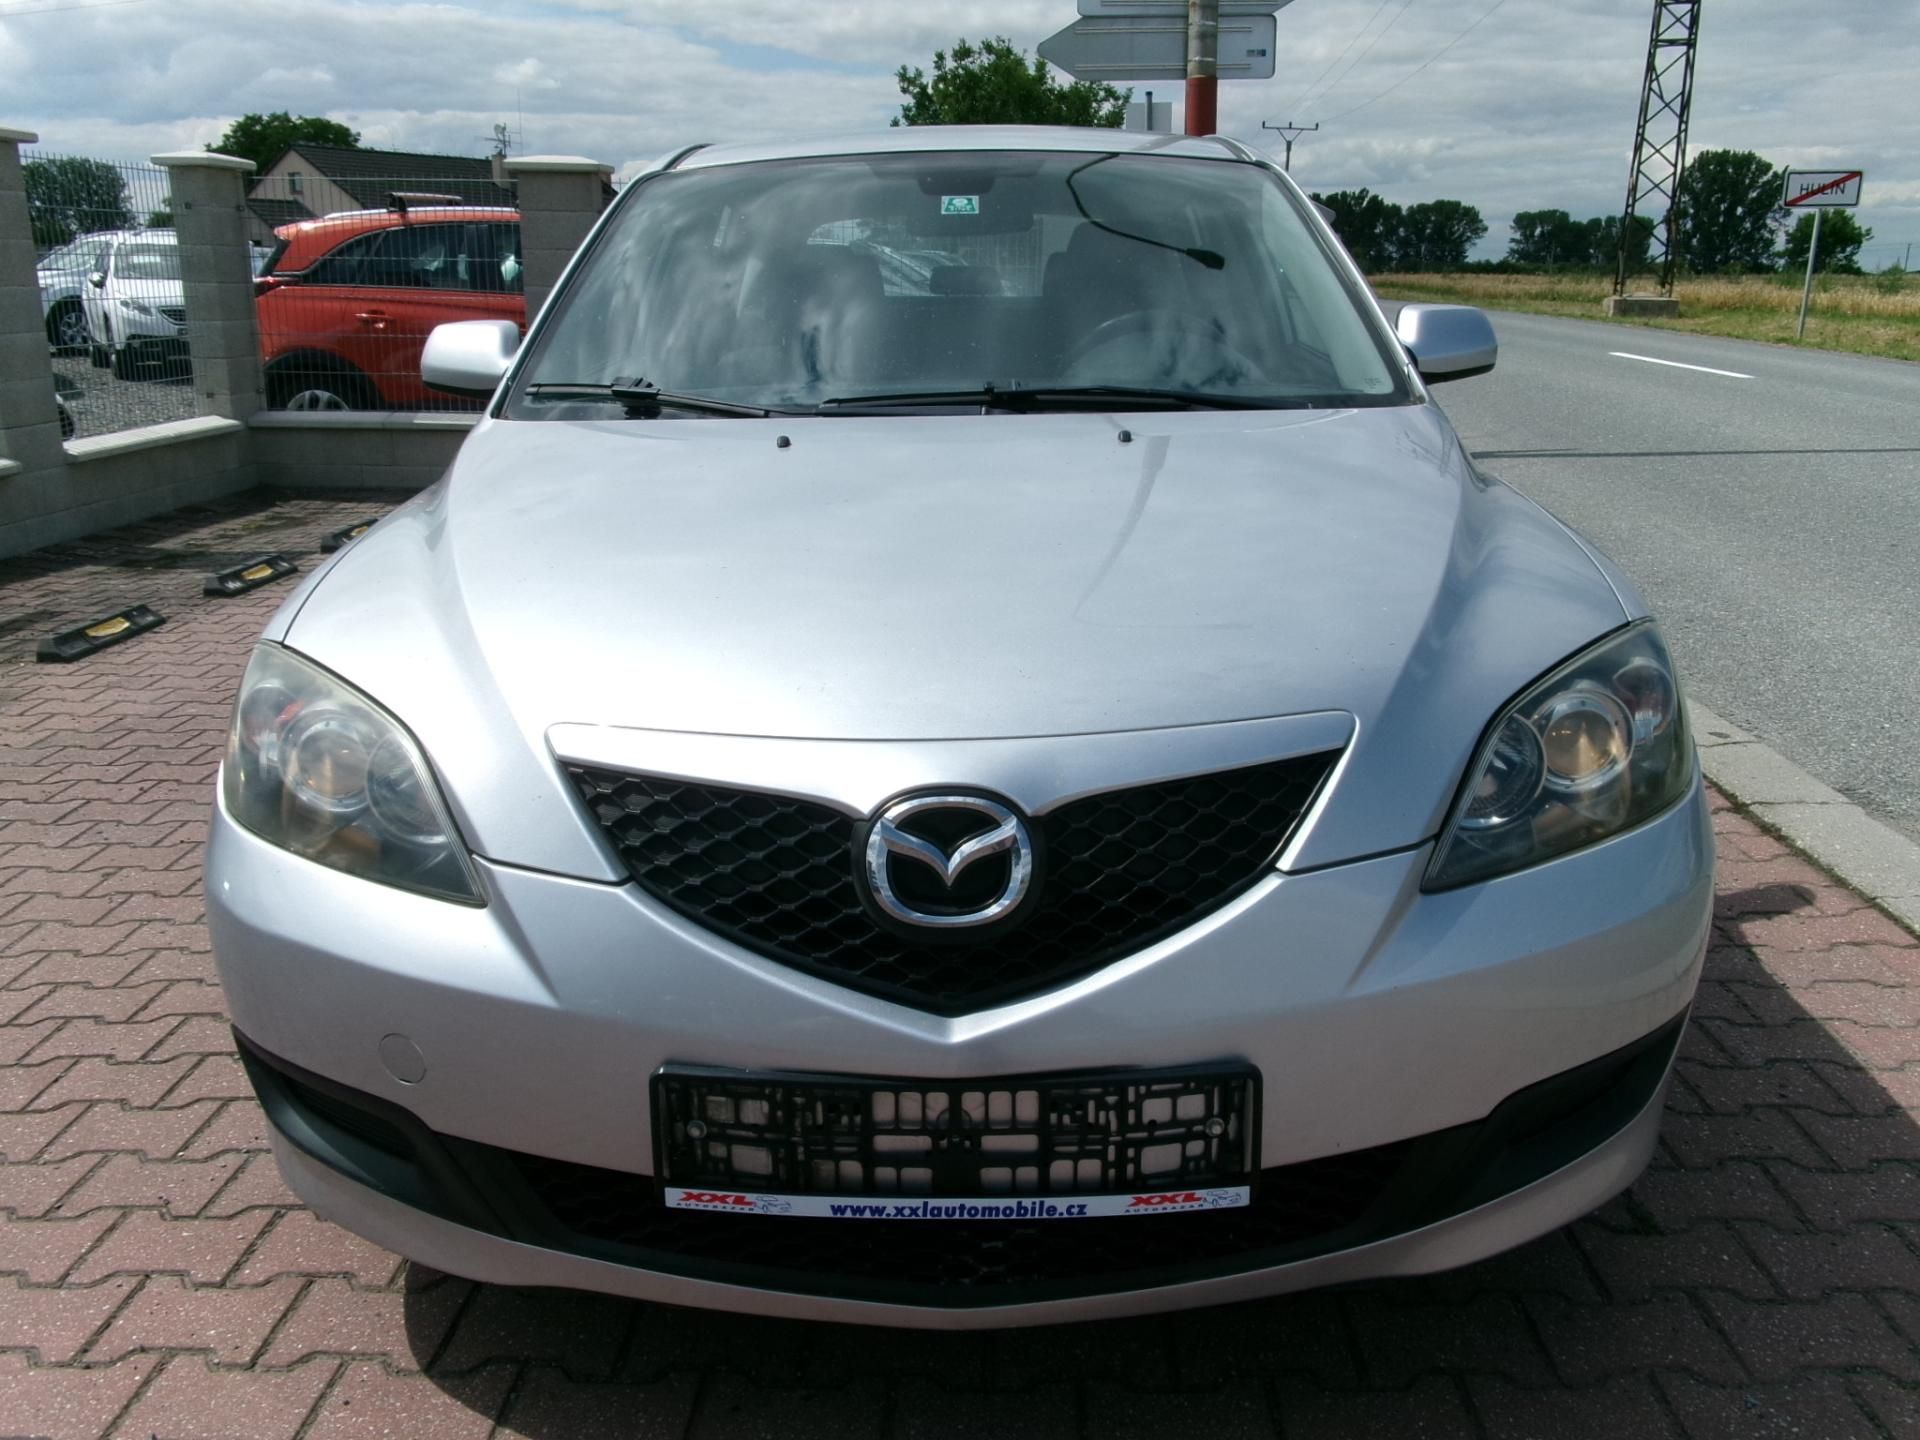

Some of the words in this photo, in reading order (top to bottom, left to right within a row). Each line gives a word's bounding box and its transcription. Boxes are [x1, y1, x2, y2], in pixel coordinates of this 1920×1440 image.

[679, 1191, 754, 1206] XXL
[1128, 1191, 1203, 1207] XXL
[829, 1200, 1088, 1218] www.xxlautomobile.cz
[1124, 1203, 1204, 1213] AUTOBAZAR
